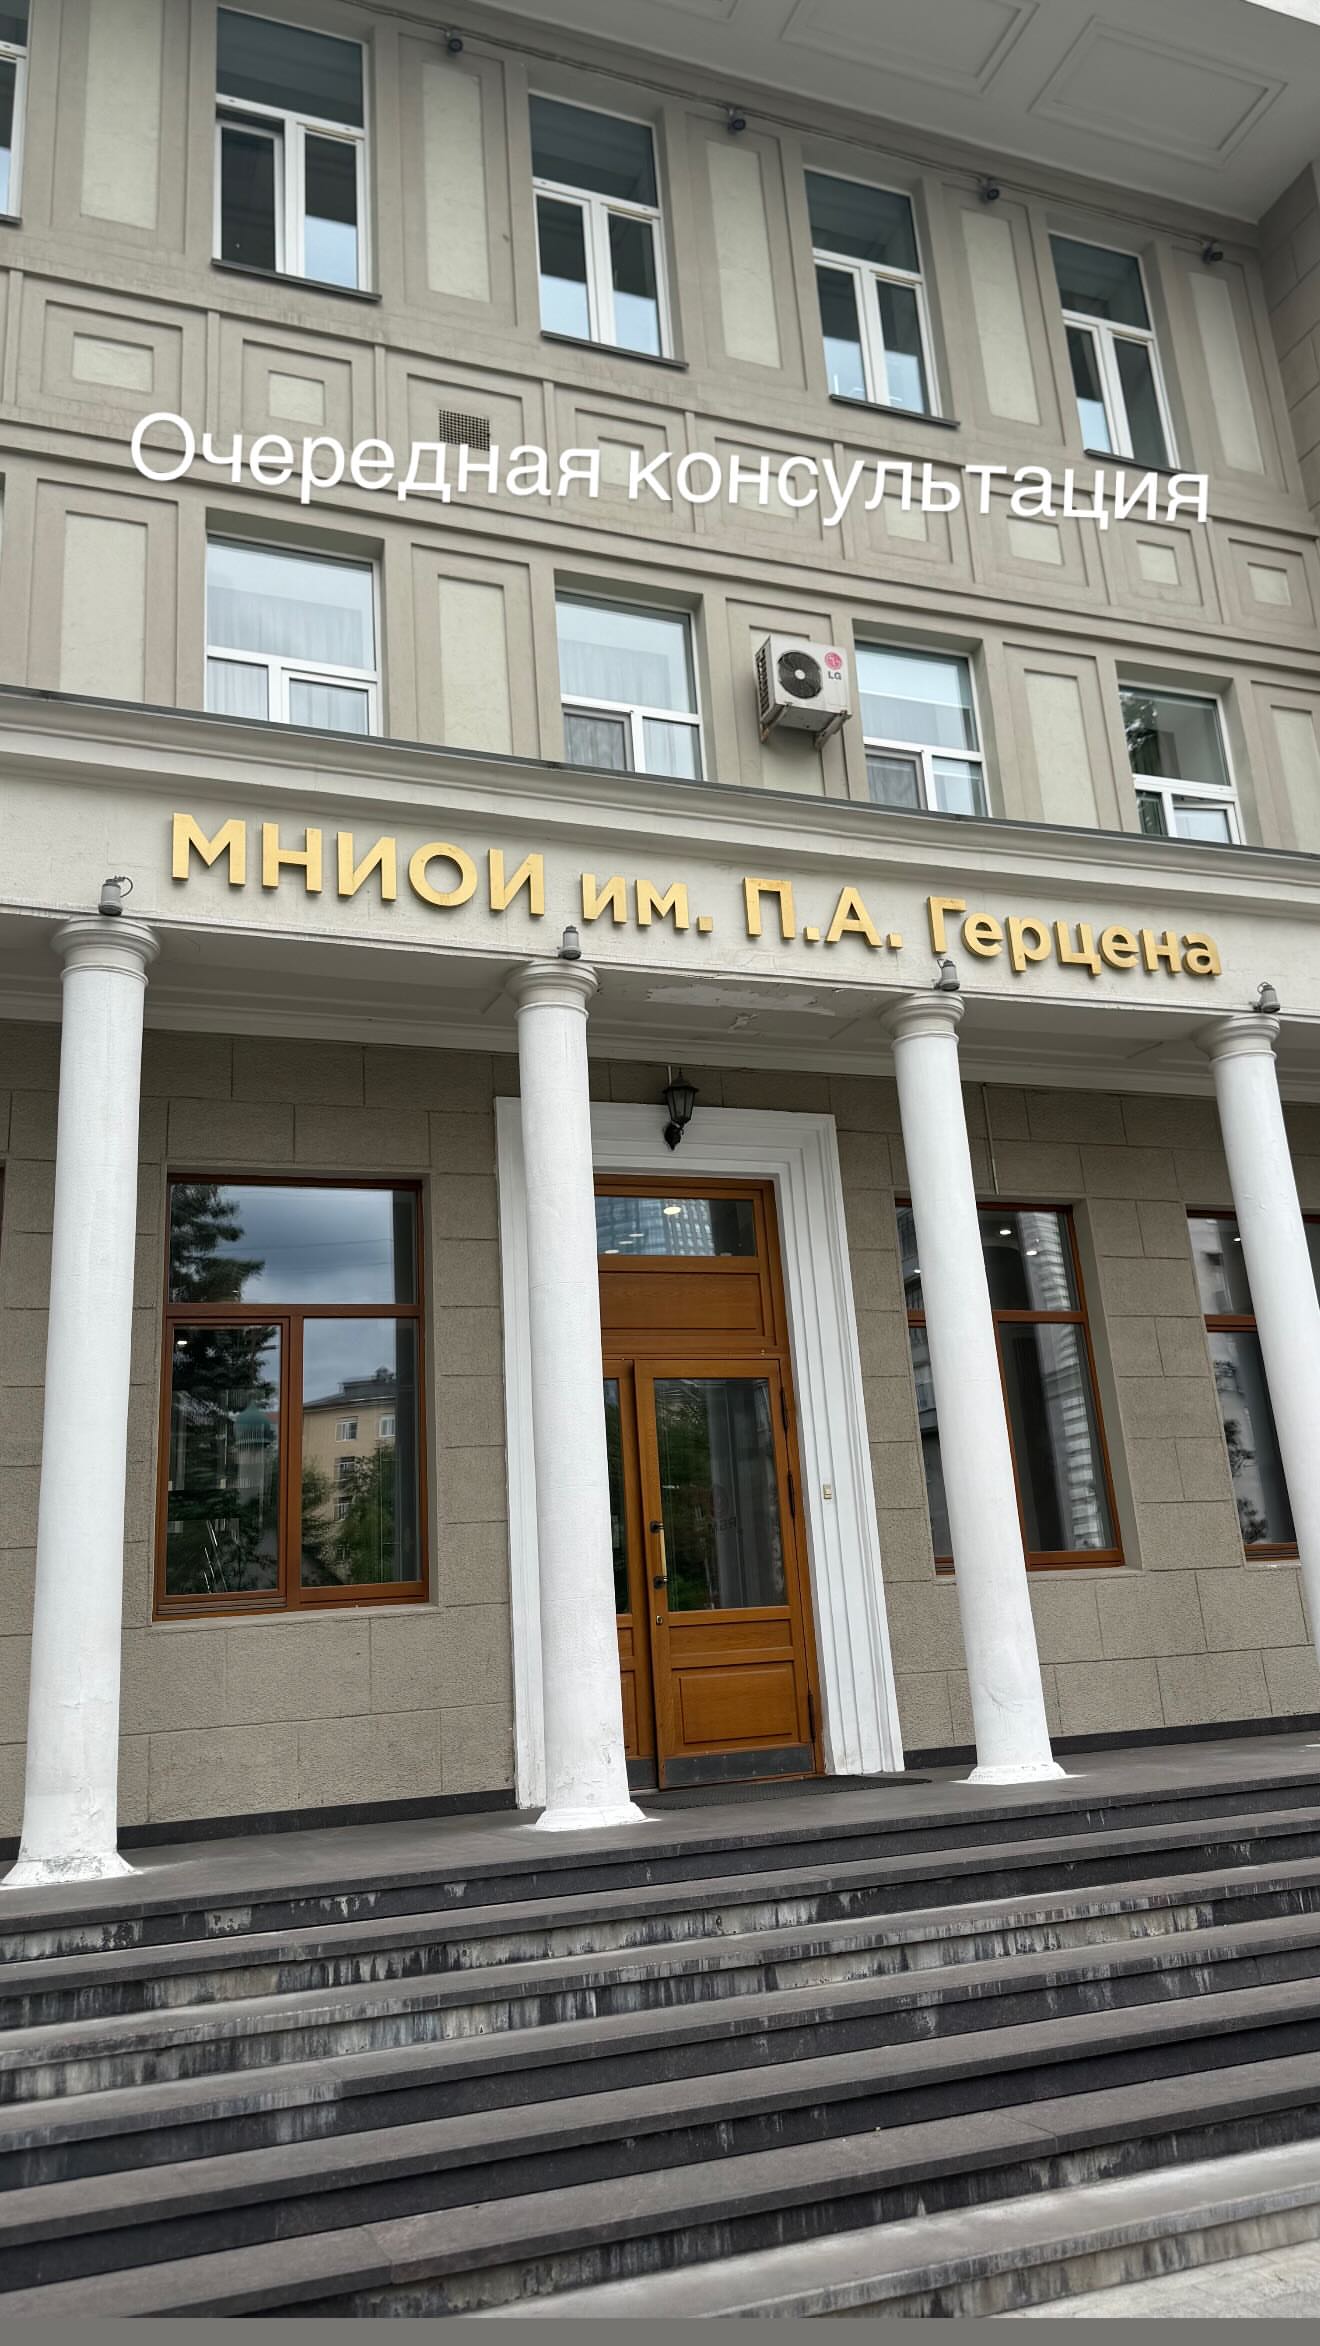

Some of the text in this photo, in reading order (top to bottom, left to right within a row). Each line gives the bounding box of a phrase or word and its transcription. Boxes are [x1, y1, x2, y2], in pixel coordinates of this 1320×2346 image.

[828, 671, 842, 681] LG
[171, 812, 1223, 977] МНИОИ им. П.А. Герцена
